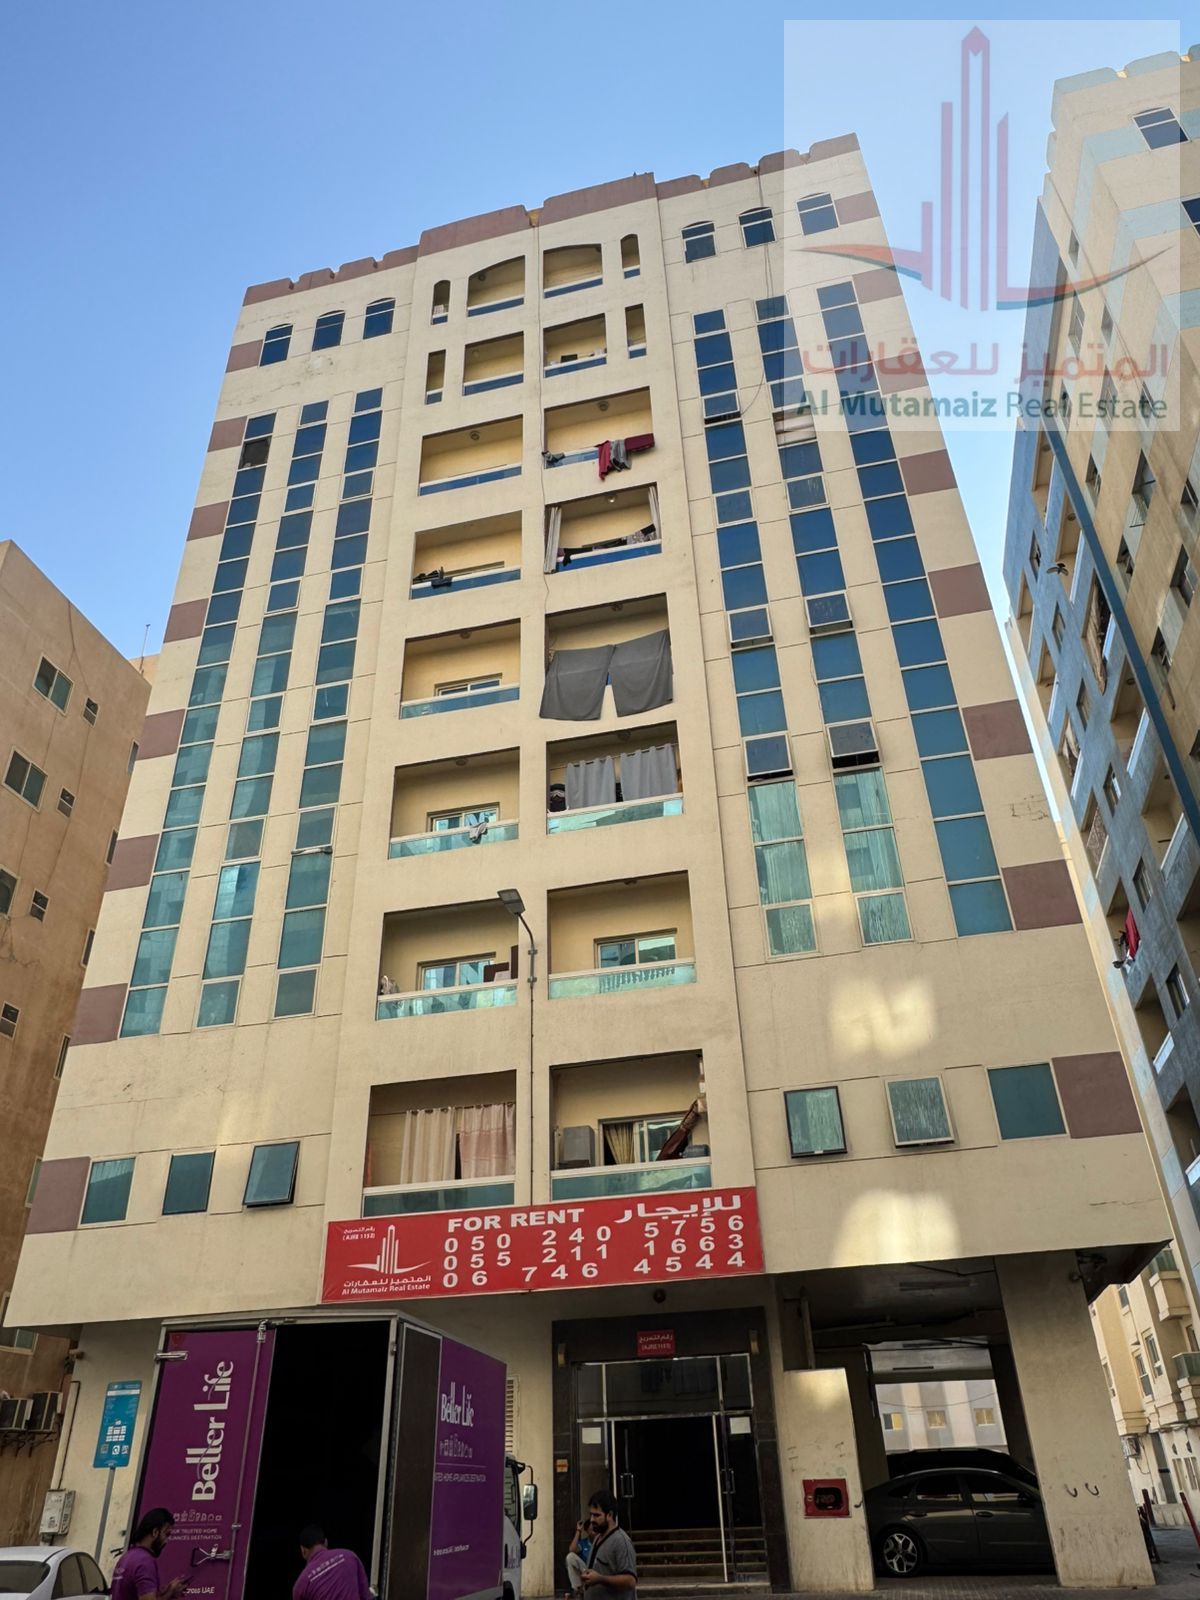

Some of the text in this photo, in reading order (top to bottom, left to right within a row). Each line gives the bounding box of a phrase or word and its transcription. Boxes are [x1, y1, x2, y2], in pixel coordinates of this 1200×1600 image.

[448, 1208, 585, 1233] FOR RENT
[614, 1194, 742, 1224] للإيجار
[444, 1215, 744, 1253] 050 240 5756
[443, 1234, 744, 1270] 055 211 1663
[442, 1251, 745, 1288] 06 746 4544
[389, 1284, 406, 1292] Real
[193, 1361, 234, 1411] Life
[201, 1586, 216, 1594] UAE
